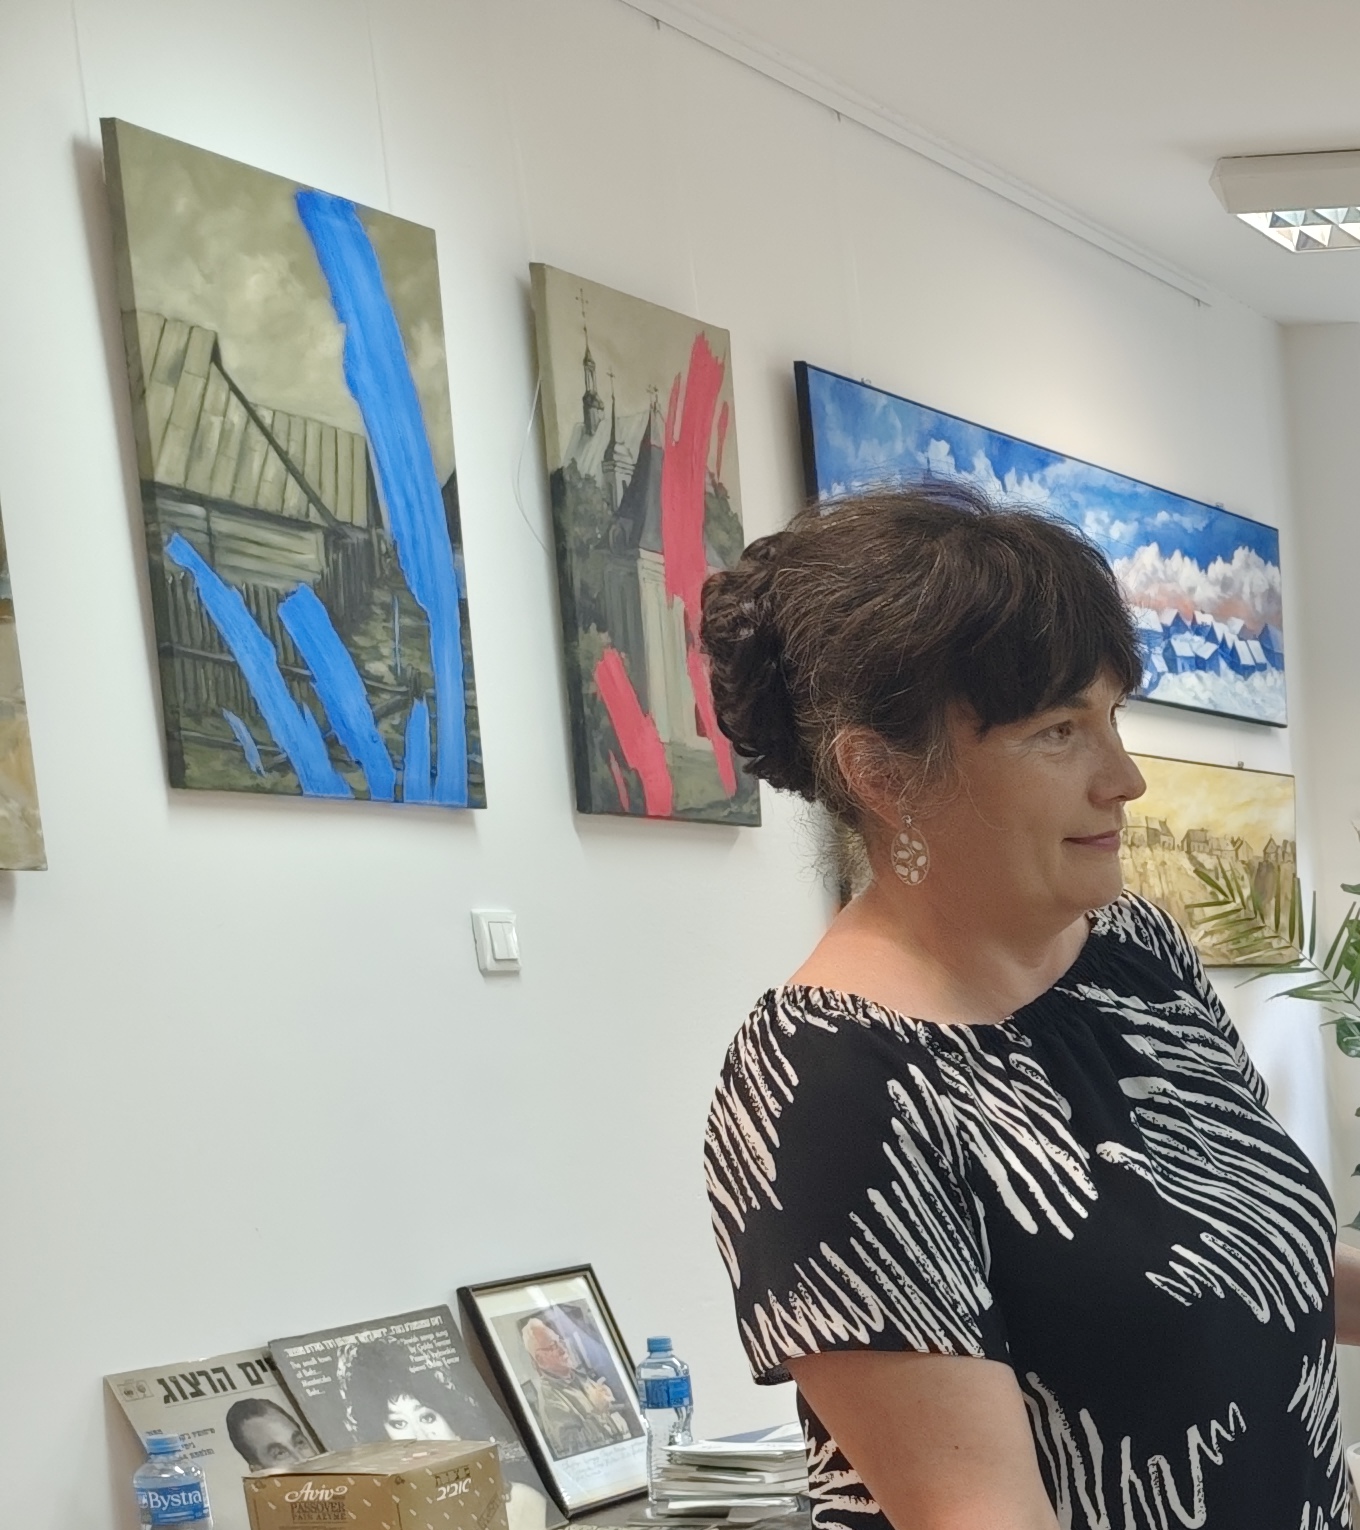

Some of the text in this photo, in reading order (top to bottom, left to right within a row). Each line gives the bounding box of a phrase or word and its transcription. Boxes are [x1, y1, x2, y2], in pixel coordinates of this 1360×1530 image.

[156, 1366, 237, 1405] הרצוג
[148, 1490, 202, 1511] Bystra
[284, 1481, 348, 1502] Aviv
[290, 1501, 346, 1513] PASSOVER
